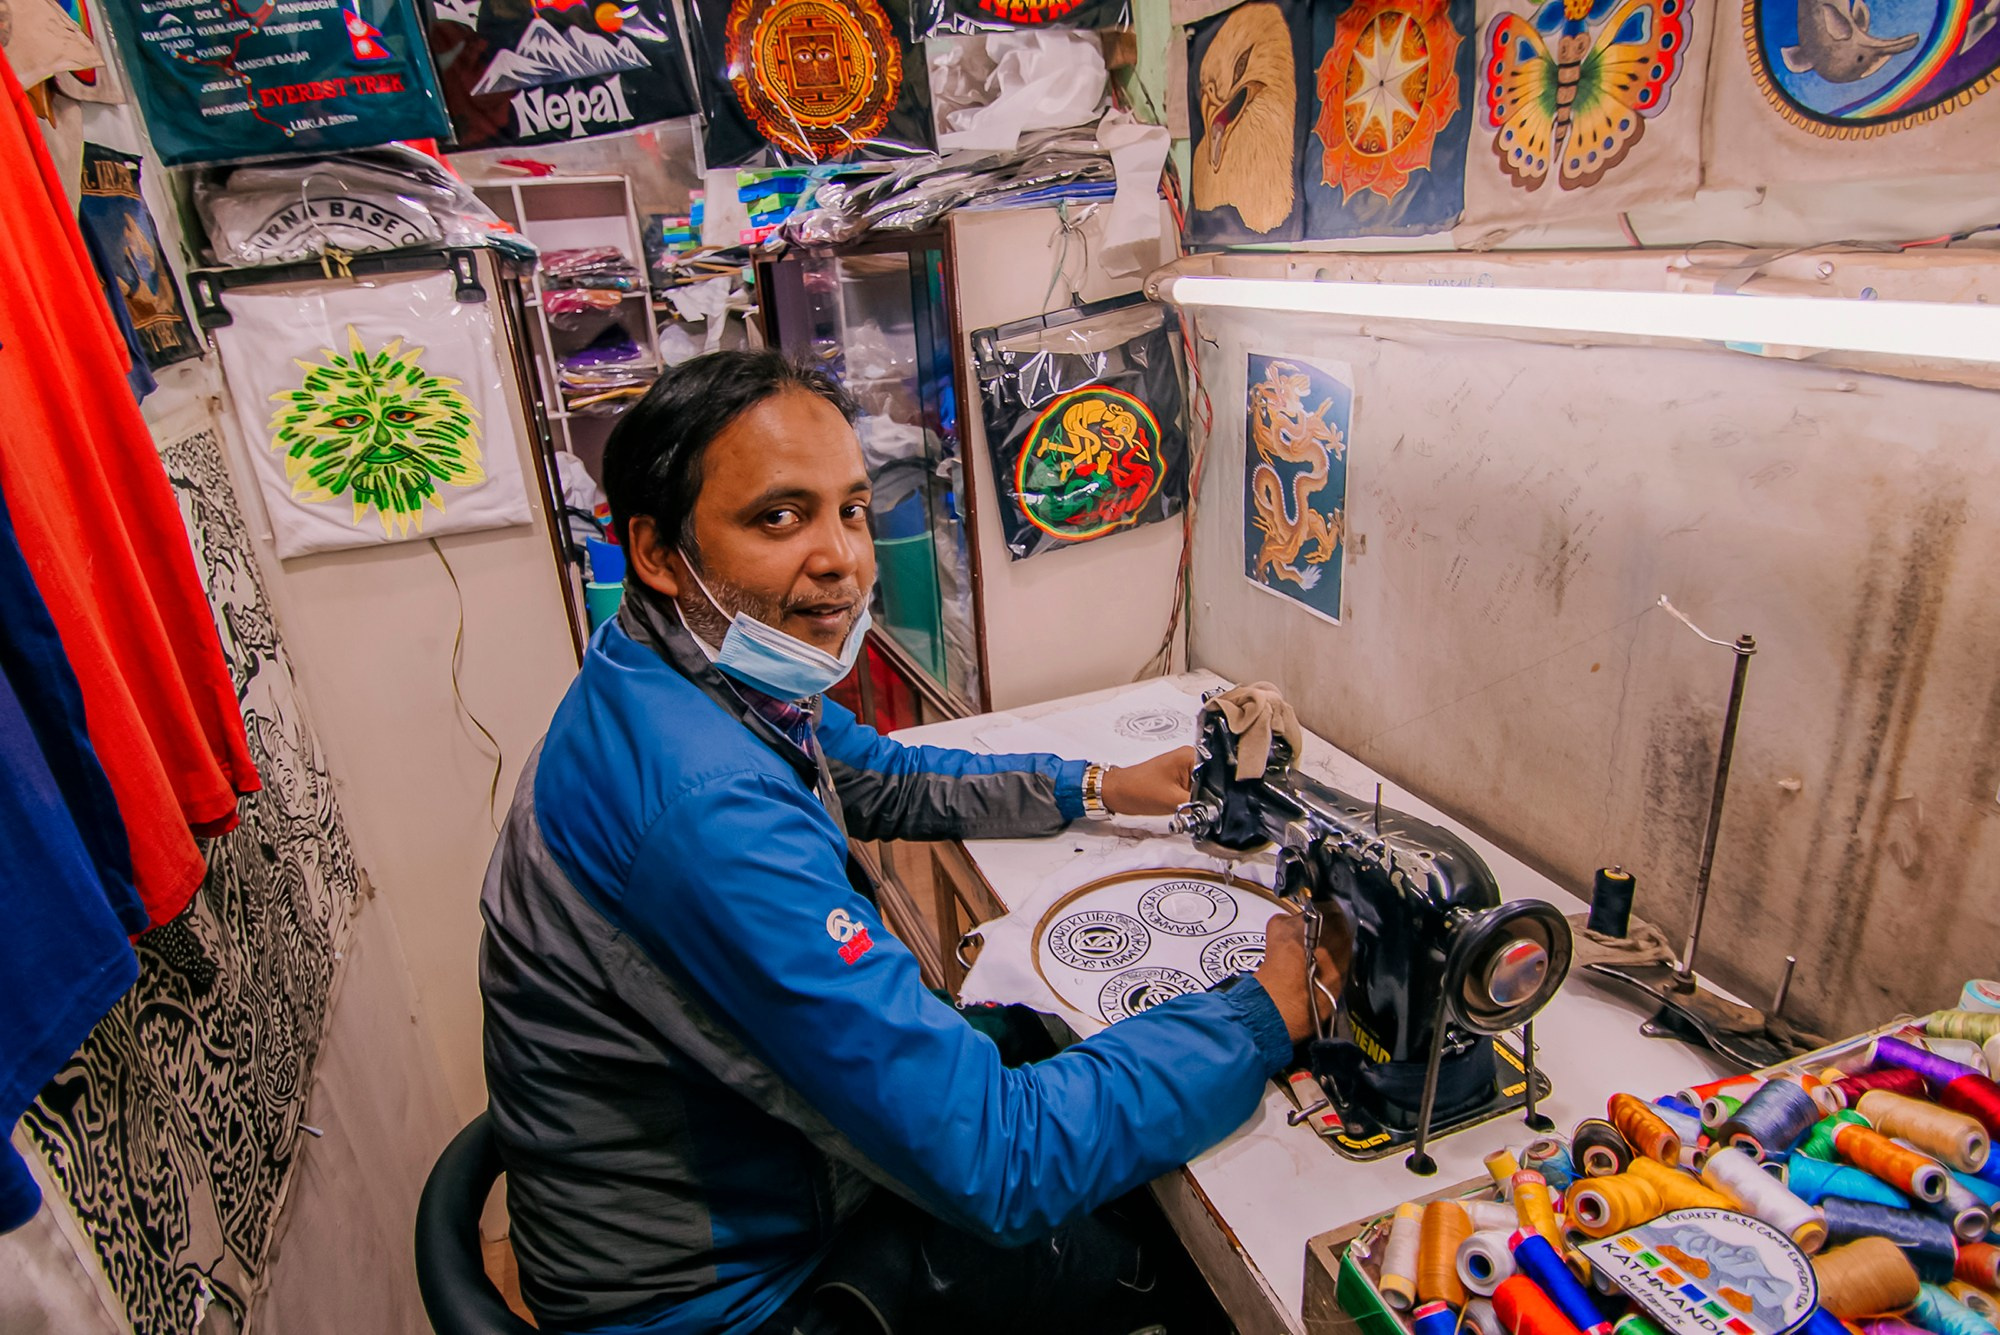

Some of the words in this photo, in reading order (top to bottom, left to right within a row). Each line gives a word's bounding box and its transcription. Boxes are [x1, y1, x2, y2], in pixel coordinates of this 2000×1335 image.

[194, 8, 222, 20] DOLE
[258, 78, 347, 108] EVEREST
[350, 73, 405, 95] TREK
[510, 73, 634, 138] Nepal
[289, 117, 327, 132] LUKLA
[329, 202, 400, 234] BASE
[1142, 883, 1205, 910] SKATEBOARD
[1068, 912, 1115, 927] KLUBB
[1144, 911, 1208, 935] DRAMMEN
[1100, 933, 1147, 969] DRAMMEN
[1202, 935, 1249, 970] DRAMMEN
[1102, 979, 1128, 1011] KLUBB
[1666, 1211, 1717, 1223] EVEREST
